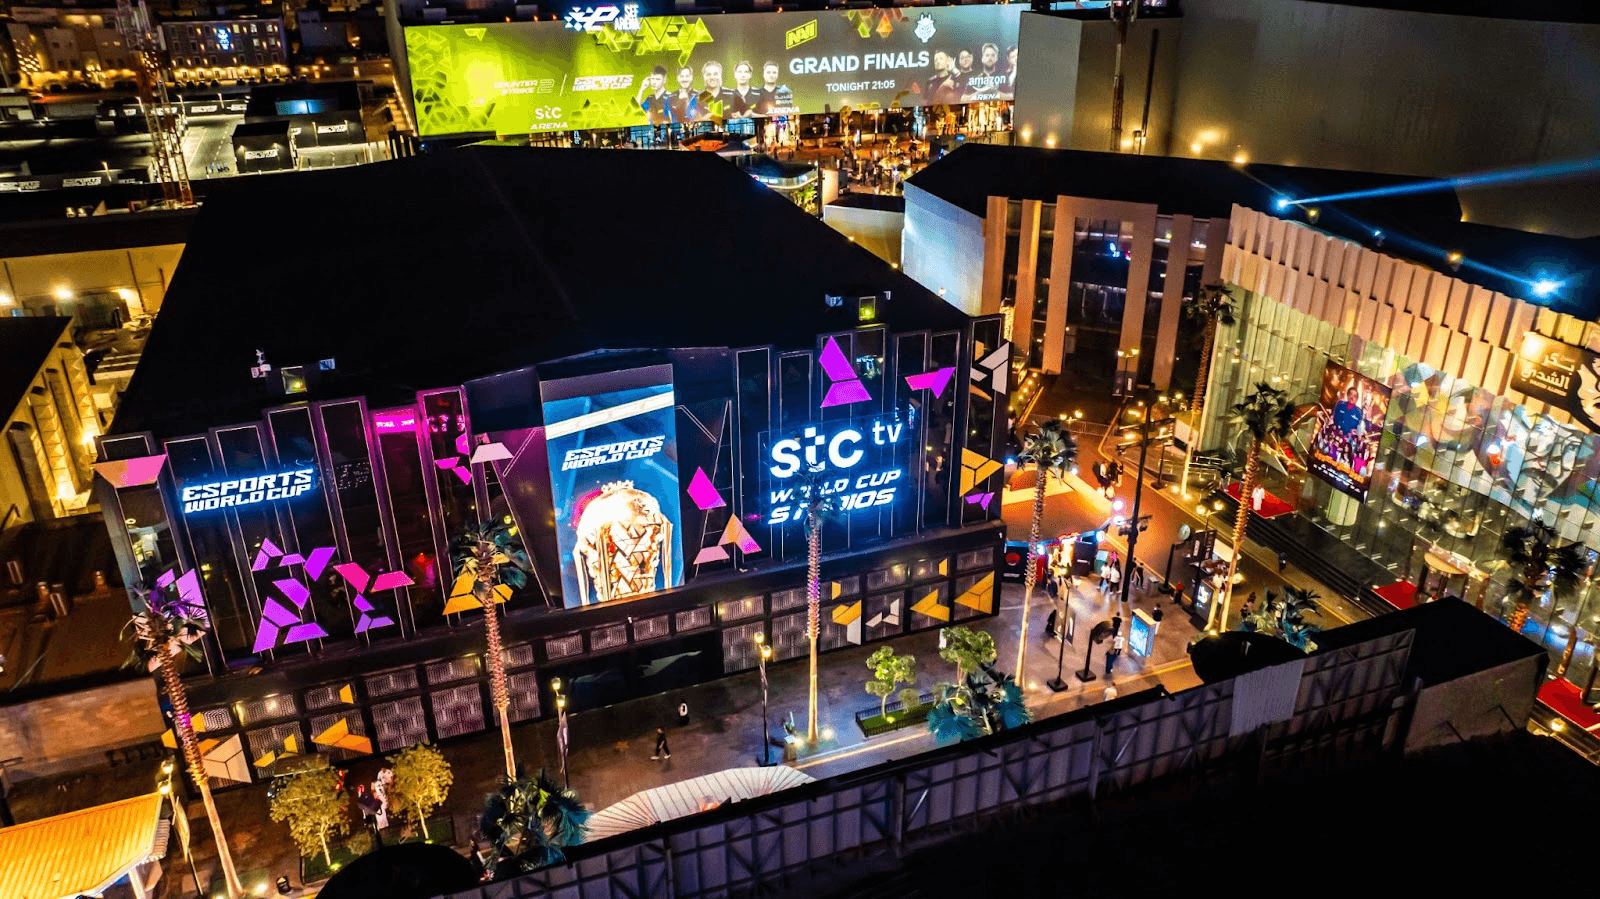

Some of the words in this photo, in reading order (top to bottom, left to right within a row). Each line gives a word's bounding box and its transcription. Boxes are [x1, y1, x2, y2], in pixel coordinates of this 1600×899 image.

[789, 55, 860, 75] GRAND
[863, 51, 930, 71] FINALS
[572, 83, 609, 91] WORLD
[610, 82, 632, 90] CUP
[574, 75, 634, 86] ESPORTS
[826, 81, 870, 93] TONIGHT
[871, 79, 896, 91] 21:05
[968, 75, 1006, 87] amazon
[534, 104, 562, 120] stc
[766, 105, 800, 115] ARENA
[530, 122, 568, 130] ARENA
[561, 452, 624, 472] WORLD
[625, 446, 662, 461] CUP
[564, 434, 666, 462] ESPORTS
[769, 426, 864, 479] stc
[872, 420, 903, 446] tv
[182, 468, 314, 502] ESPORTS
[770, 478, 850, 505] WLD
[855, 469, 902, 490] CUP
[184, 489, 265, 514] WORLD
[265, 483, 312, 501] CUP
[767, 487, 897, 525] STIOS
